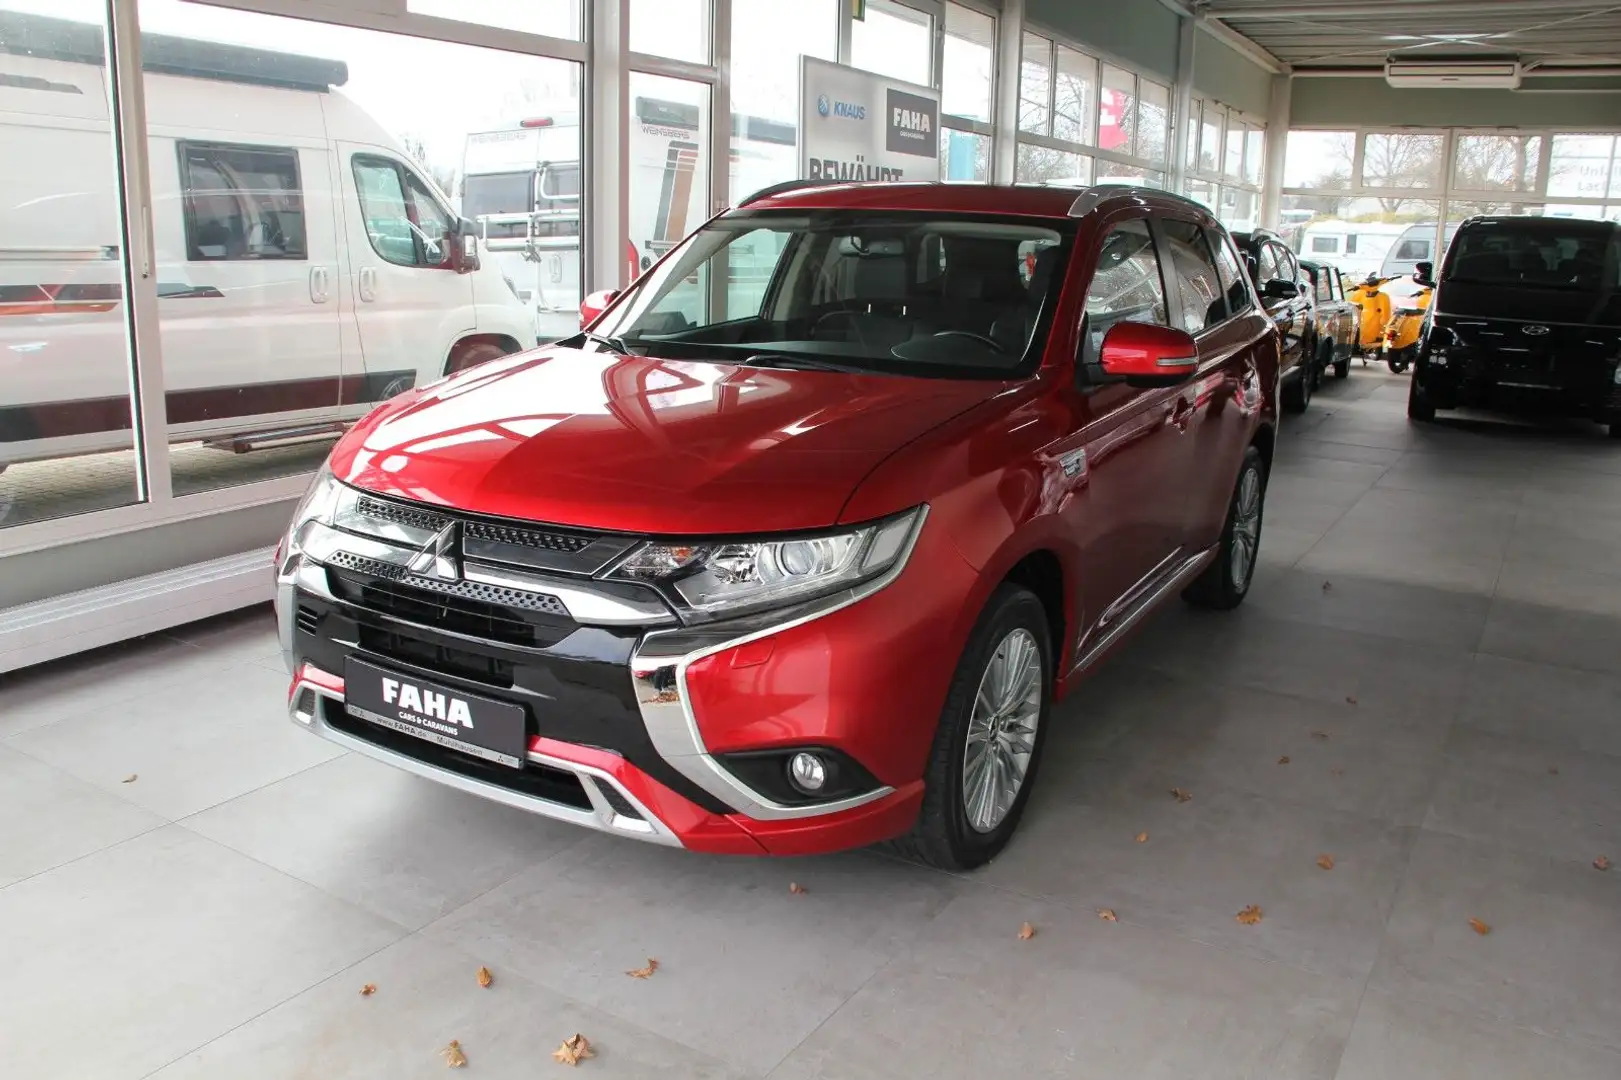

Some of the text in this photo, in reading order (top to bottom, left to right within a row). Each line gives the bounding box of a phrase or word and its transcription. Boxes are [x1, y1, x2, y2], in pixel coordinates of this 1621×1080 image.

[833, 101, 866, 120] KNAUS
[893, 107, 931, 133] FAHA
[382, 677, 474, 728] FAHA
[376, 717, 427, 739] www.FAHA.de
[398, 711, 458, 736] CARS & CARAVANS
